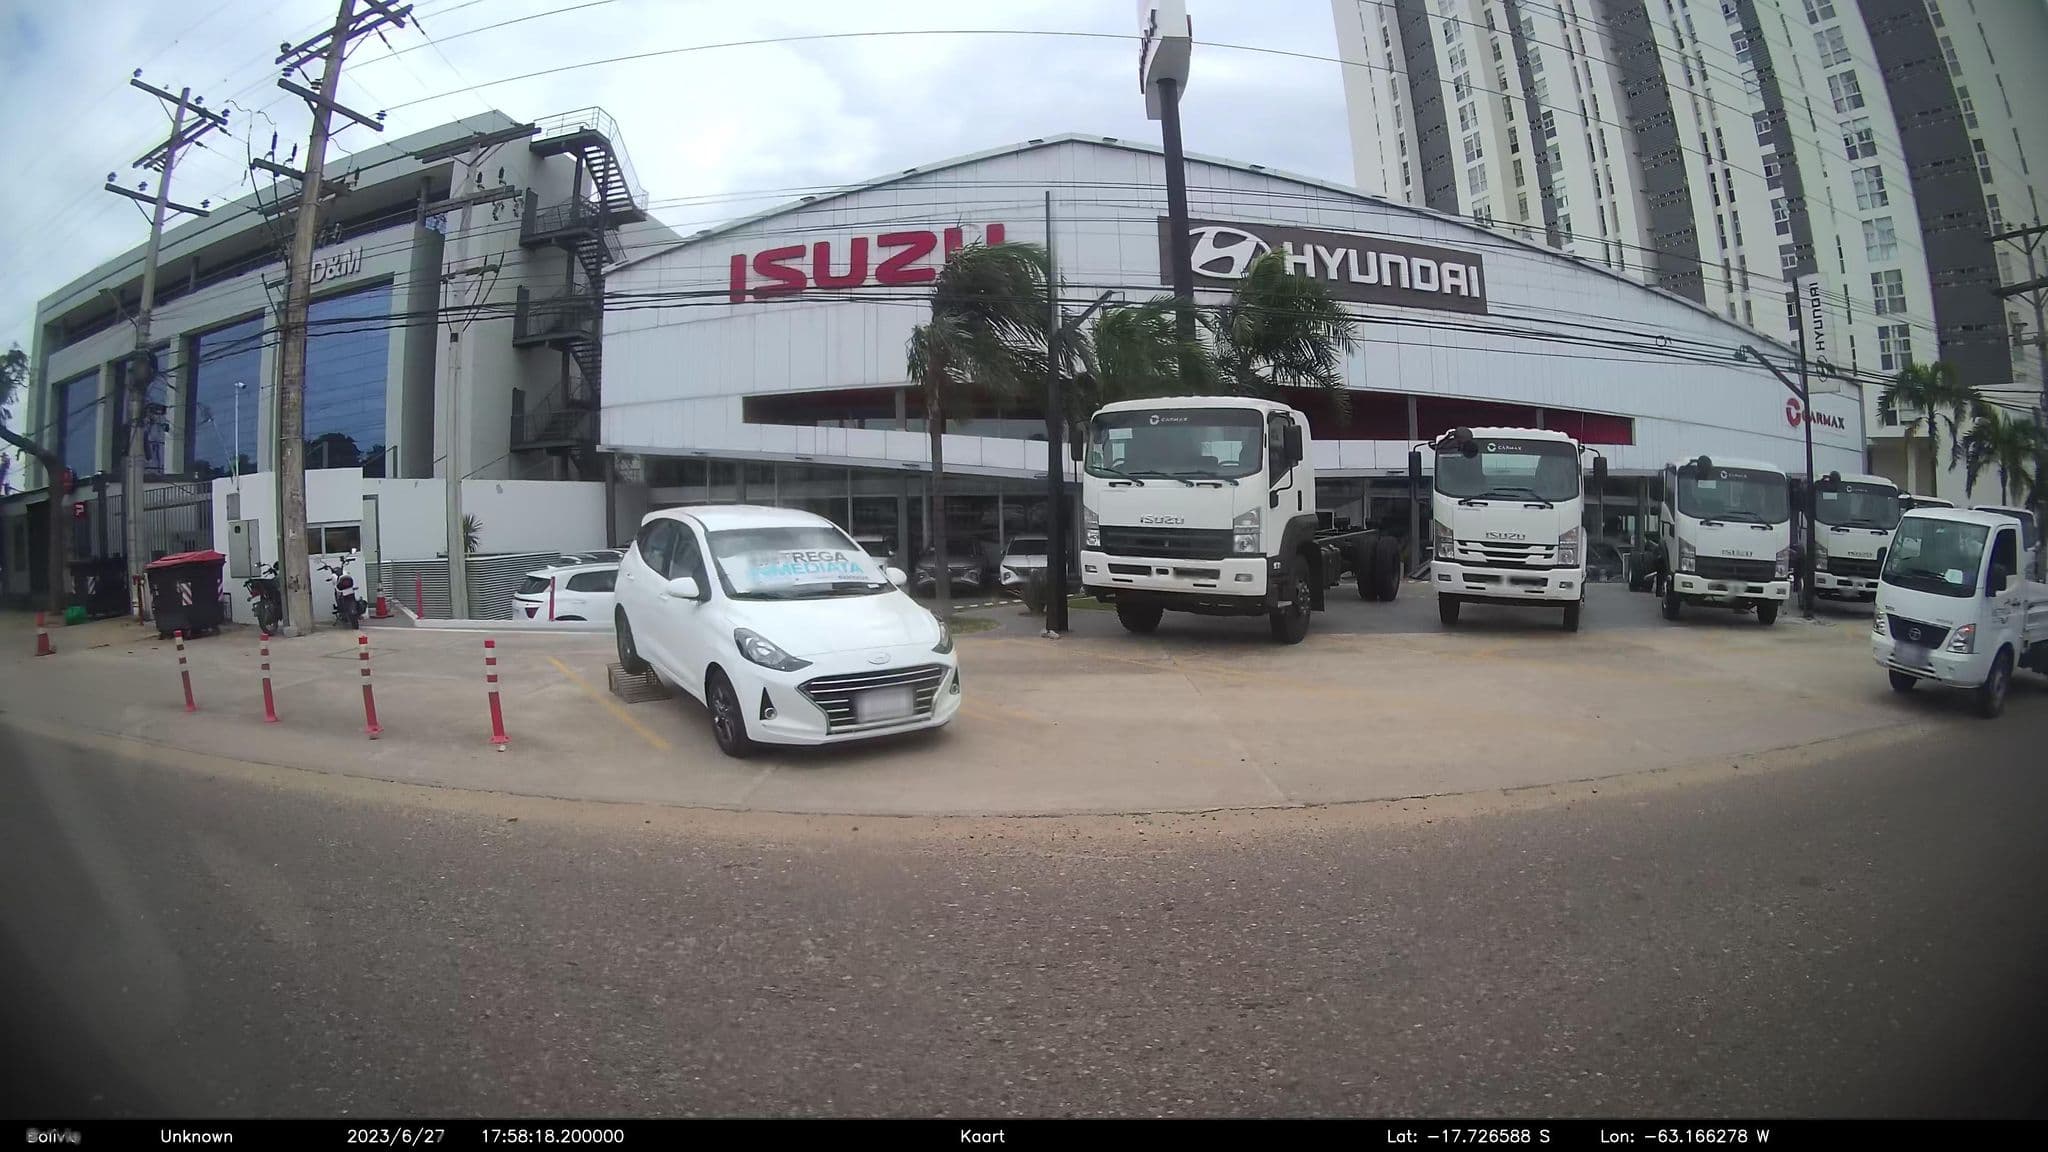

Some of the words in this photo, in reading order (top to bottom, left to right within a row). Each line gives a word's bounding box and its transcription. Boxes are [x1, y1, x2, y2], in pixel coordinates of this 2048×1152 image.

[310, 246, 363, 284] D&M
[1283, 241, 1481, 298] HYUNDAI
[1808, 281, 1825, 351] HYUNDAI
[1140, 514, 1185, 525] ISUZU
[1485, 531, 1526, 541] ISUZU
[751, 551, 848, 563] TREGA
[749, 561, 864, 577] MEDIATA
